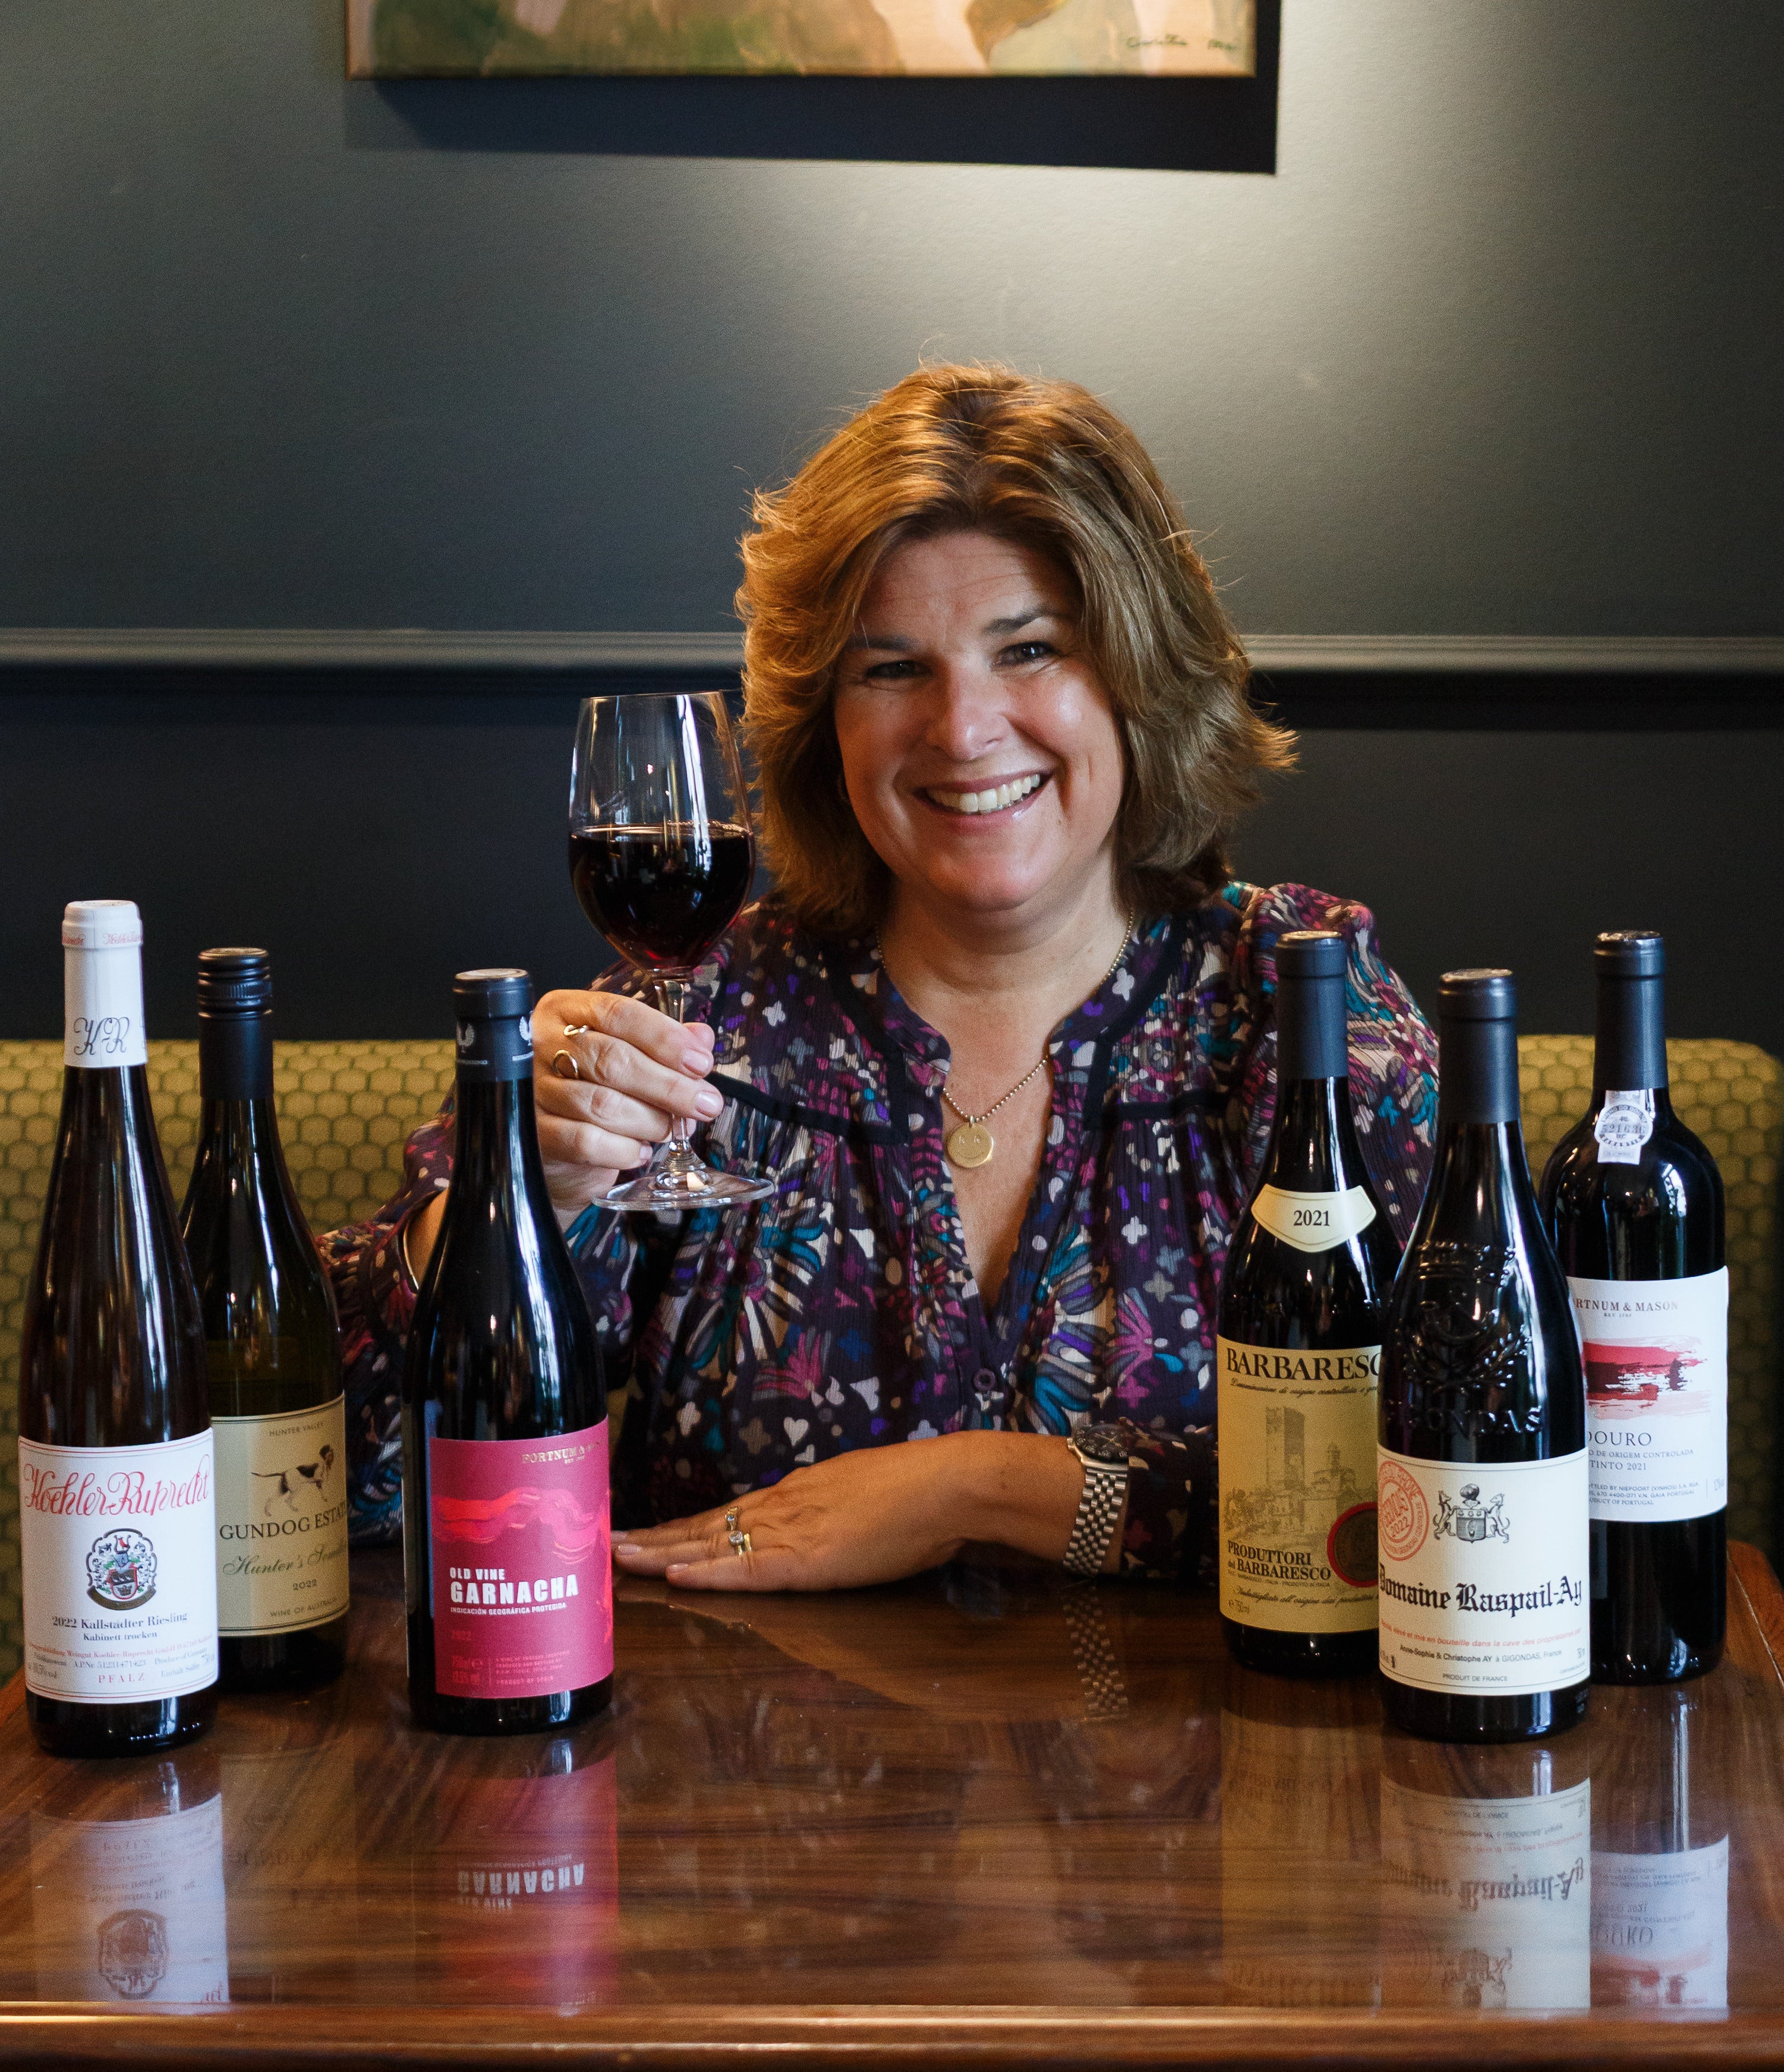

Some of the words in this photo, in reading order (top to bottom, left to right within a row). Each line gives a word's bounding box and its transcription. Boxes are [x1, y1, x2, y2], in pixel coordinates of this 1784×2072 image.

[1293, 1210, 1330, 1226] 2021
[1572, 1298, 1619, 1311] RTNUM
[1623, 1303, 1631, 1311] &
[1635, 1301, 1678, 1311] MASON
[1227, 1348, 1382, 1380] BARBARESC
[522, 1447, 577, 1464] FORTNUM
[1643, 1449, 1693, 1458] CONTROLADA
[1589, 1459, 1623, 1469] TINTO
[219, 1516, 310, 1540] GUNDOG
[315, 1501, 347, 1529] ESTAT
[1227, 1540, 1312, 1566] PRODUTTORI
[223, 1554, 303, 1575] Hunter's
[1237, 1557, 1331, 1580] BARBARESCO
[450, 1567, 471, 1580] OLD
[475, 1568, 505, 1581] VINE
[450, 1573, 579, 1604] GARNACHA
[1456, 1576, 1581, 1617] Raspail-Ay
[450, 1607, 487, 1615] INDICACIÓN
[488, 1606, 530, 1616] GEOGRÁFICA
[531, 1602, 566, 1613] PROTEGIDA
[52, 1616, 77, 1628] 2022
[81, 1619, 144, 1629] Kallstadter
[147, 1613, 188, 1626] Riesling
[124, 1631, 157, 1640] trocken
[1437, 1637, 1470, 1646] bouteille
[67, 1650, 92, 1659] Weingut
[1400, 1645, 1435, 1659] Anne-Sophie
[1443, 1652, 1481, 1663] Christophe
[1543, 1650, 1562, 1658] France
[1442, 1673, 1470, 1681] PRODUIT
